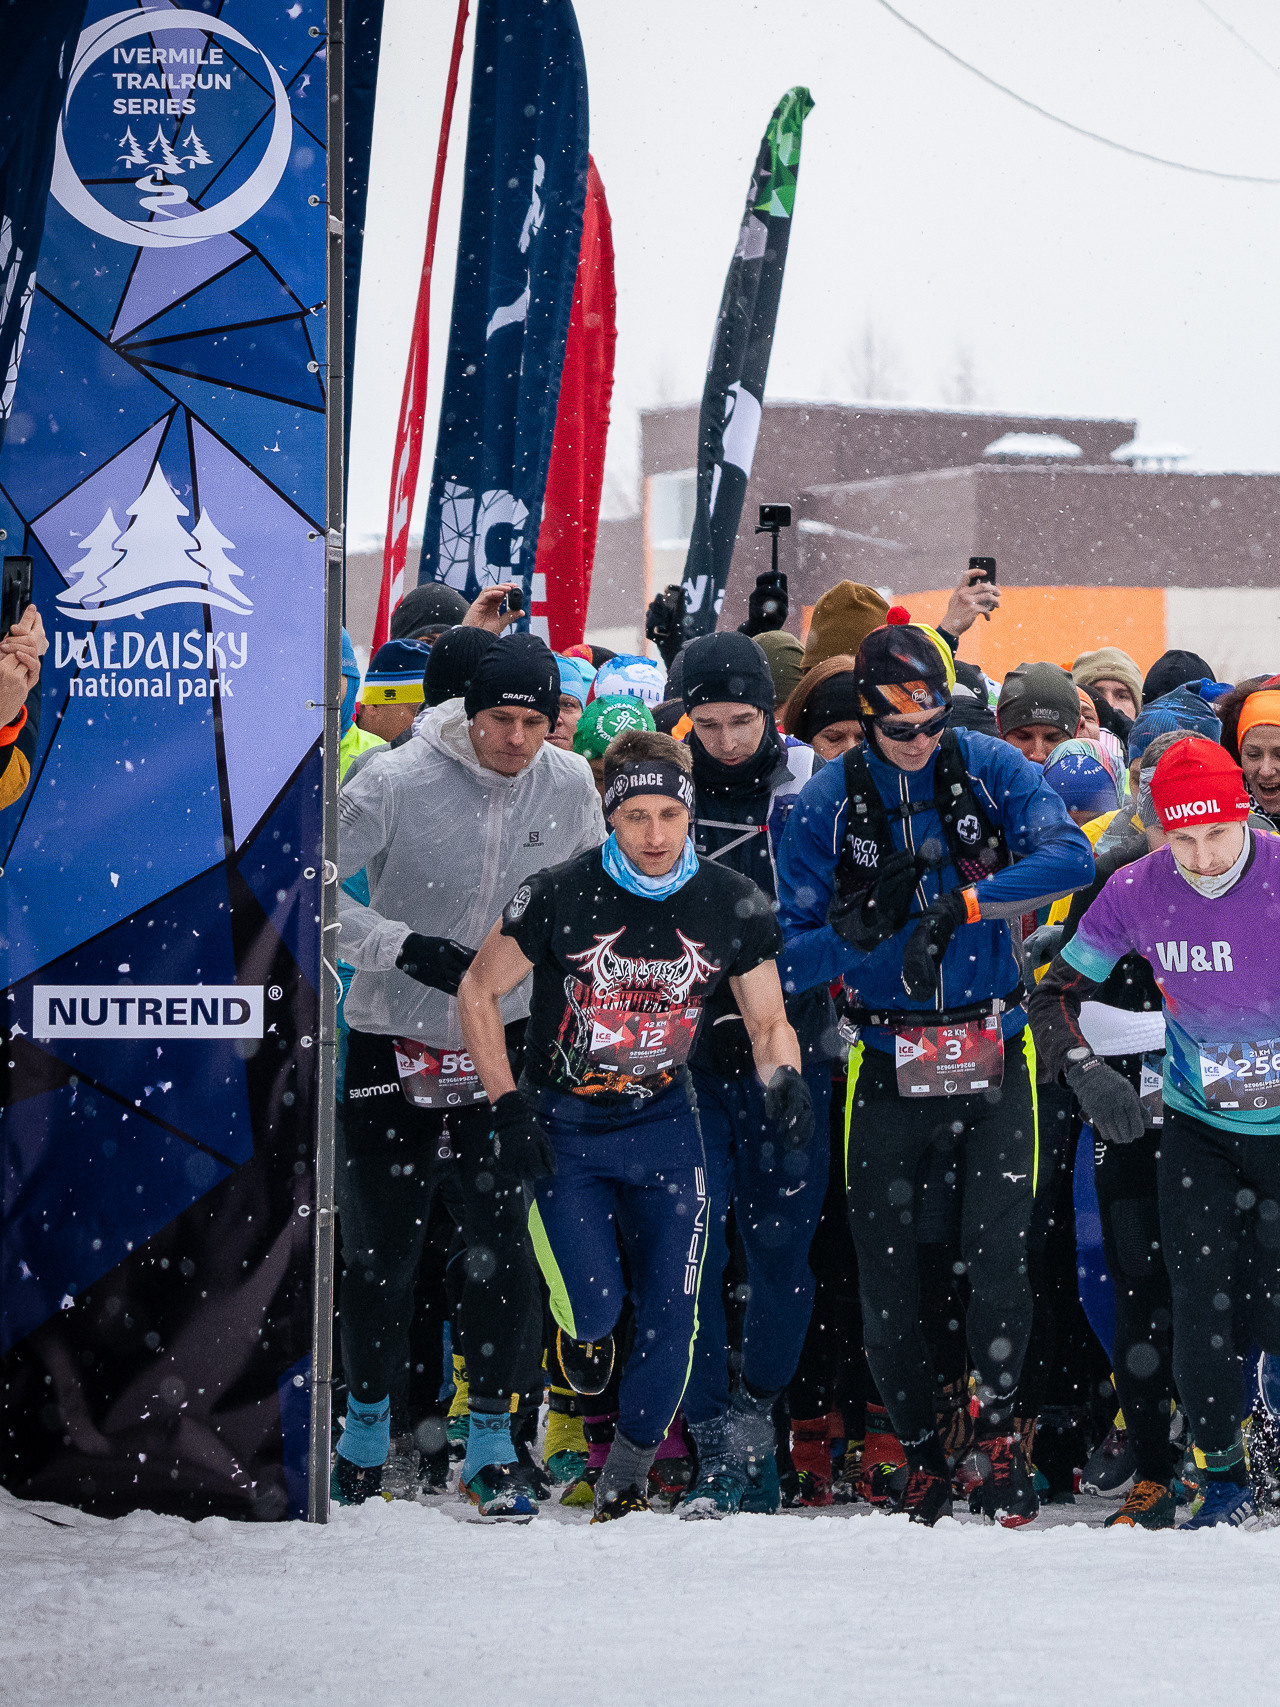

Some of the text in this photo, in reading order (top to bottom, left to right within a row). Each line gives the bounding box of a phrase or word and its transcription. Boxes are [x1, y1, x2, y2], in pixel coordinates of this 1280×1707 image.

[112, 47, 224, 66] IVERMILE
[112, 72, 232, 91] TRAILRUN
[112, 98, 197, 115] SERIES
[54, 631, 249, 670] VALDAISKY
[69, 672, 235, 705] national park
[502, 692, 530, 702] CRAFT
[629, 773, 664, 788] RACE
[1164, 799, 1221, 821] LUKOIL
[1155, 940, 1234, 973] W&R
[48, 997, 252, 1026] NUTREND
[595, 1032, 611, 1041] ICE
[639, 1029, 665, 1048] 12
[942, 1029, 953, 1037] 42
[945, 1039, 962, 1060] 3
[1258, 1049, 1271, 1057] KM
[441, 1053, 476, 1074] 58
[1204, 1066, 1220, 1074] ICE
[349, 1082, 400, 1099] salomon
[1144, 1077, 1160, 1085] ICE
[683, 1166, 707, 1295] SPINE
